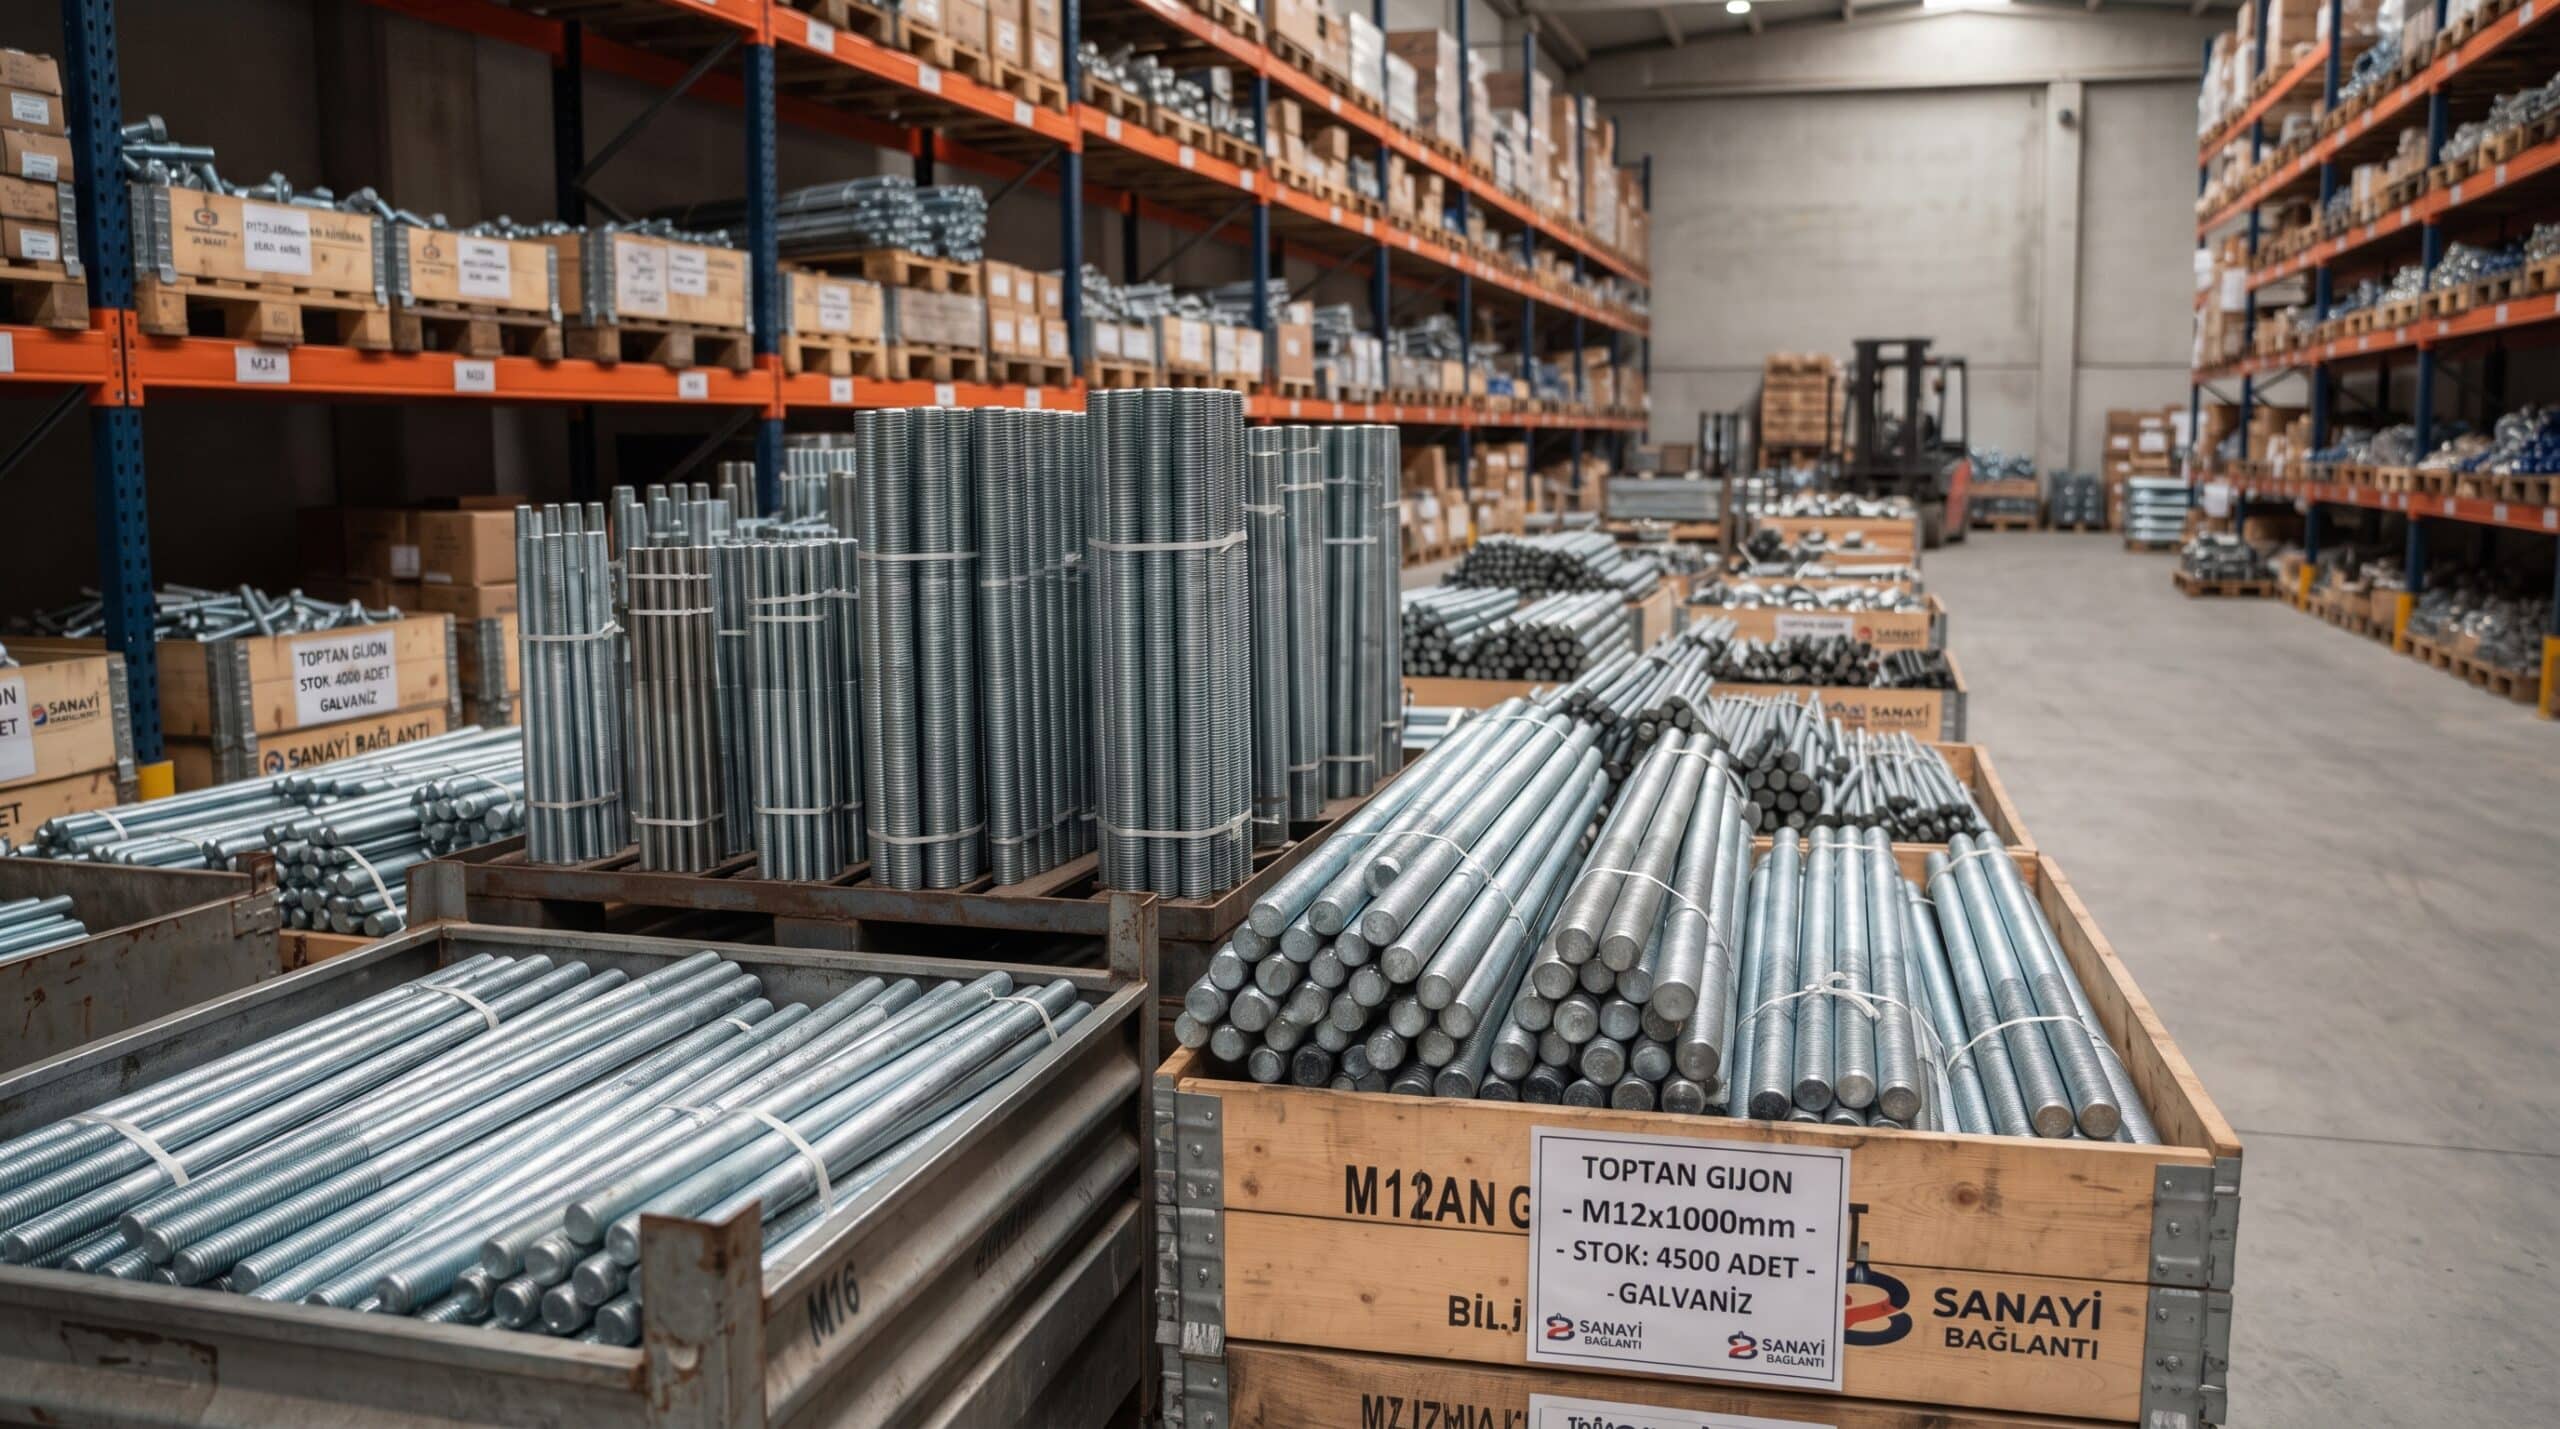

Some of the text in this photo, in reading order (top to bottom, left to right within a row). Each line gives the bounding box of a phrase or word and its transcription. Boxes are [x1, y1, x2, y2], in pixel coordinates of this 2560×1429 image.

[299, 648, 349, 667] TOPTAN
[363, 665, 391, 682] ADET
[289, 731, 350, 769] SANAYİ
[1582, 1154, 1794, 1195] TOPTAN GIJON
[1344, 1164, 1497, 1227] M12AN
[1582, 1199, 1796, 1239] M12x1000mm
[1573, 1240, 1649, 1268] STOK:
[1656, 1246, 1721, 1273] 4500
[1727, 1254, 1800, 1279] ADET
[805, 1260, 861, 1347] M16
[1932, 1287, 2103, 1331] SANAYİ
[1579, 1320, 1643, 1338] SANAYİ
[1762, 1338, 1825, 1356] SANAYİ
[1944, 1326, 2099, 1361] BAĞLANTI
